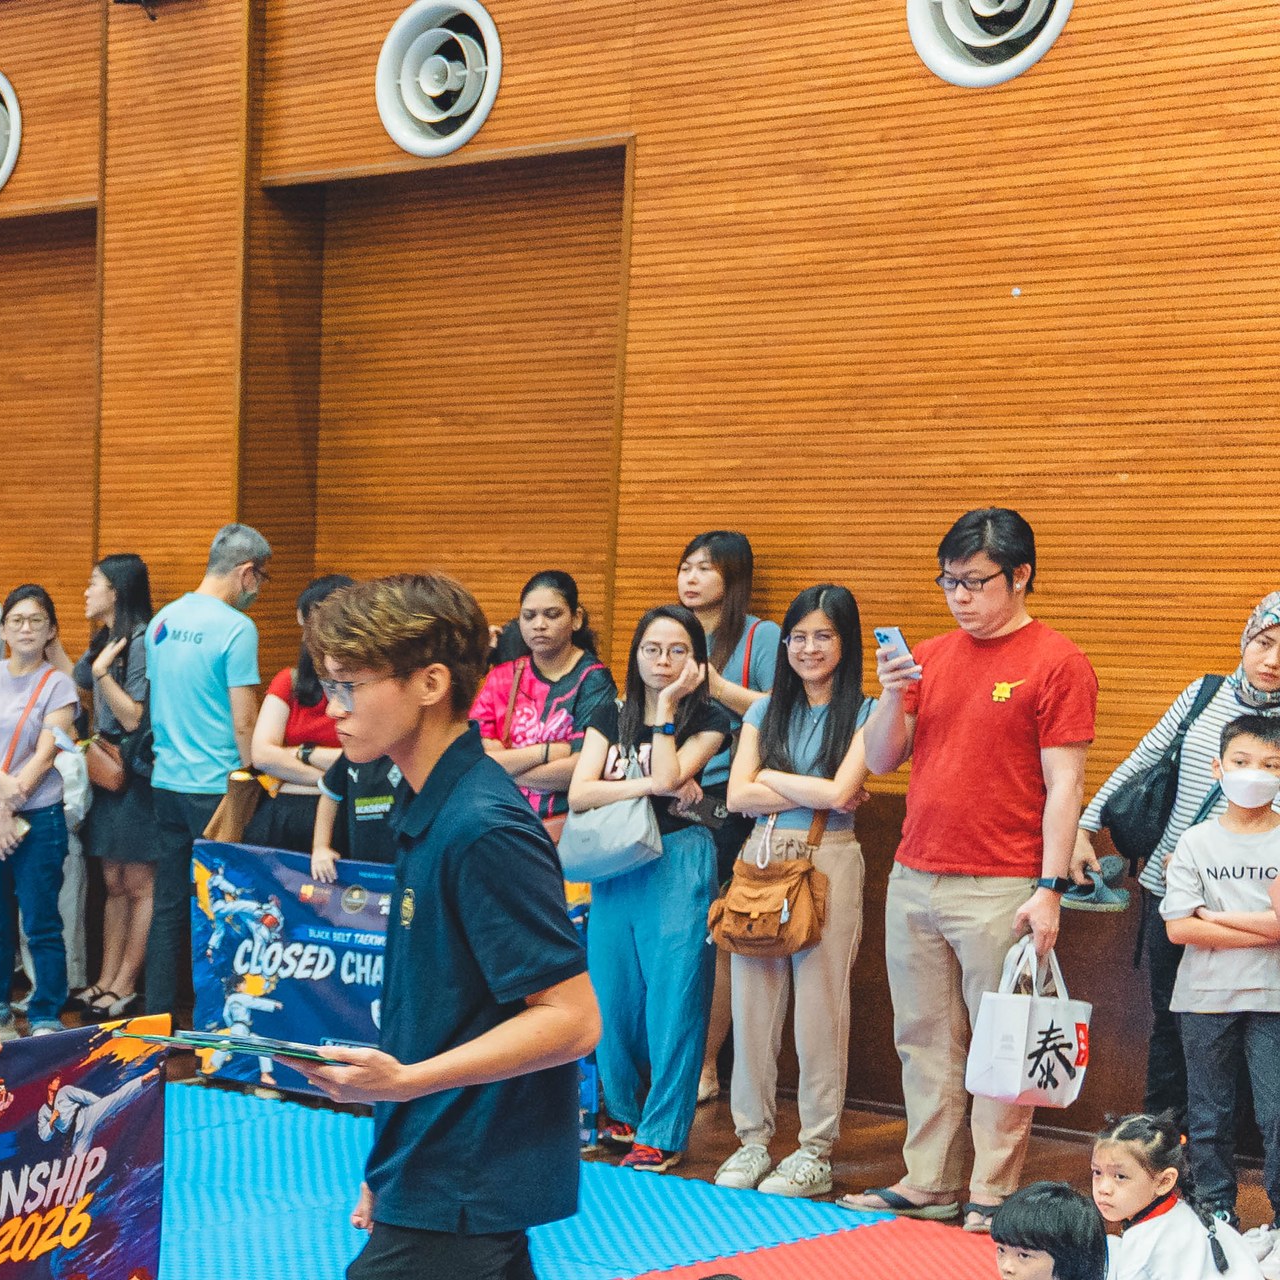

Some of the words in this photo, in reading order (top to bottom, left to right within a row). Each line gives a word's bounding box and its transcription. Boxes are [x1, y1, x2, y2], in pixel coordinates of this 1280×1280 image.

[171, 630, 203, 645] MSIG
[233, 938, 337, 981] CLOSED
[1027, 1019, 1077, 1090] 泰
